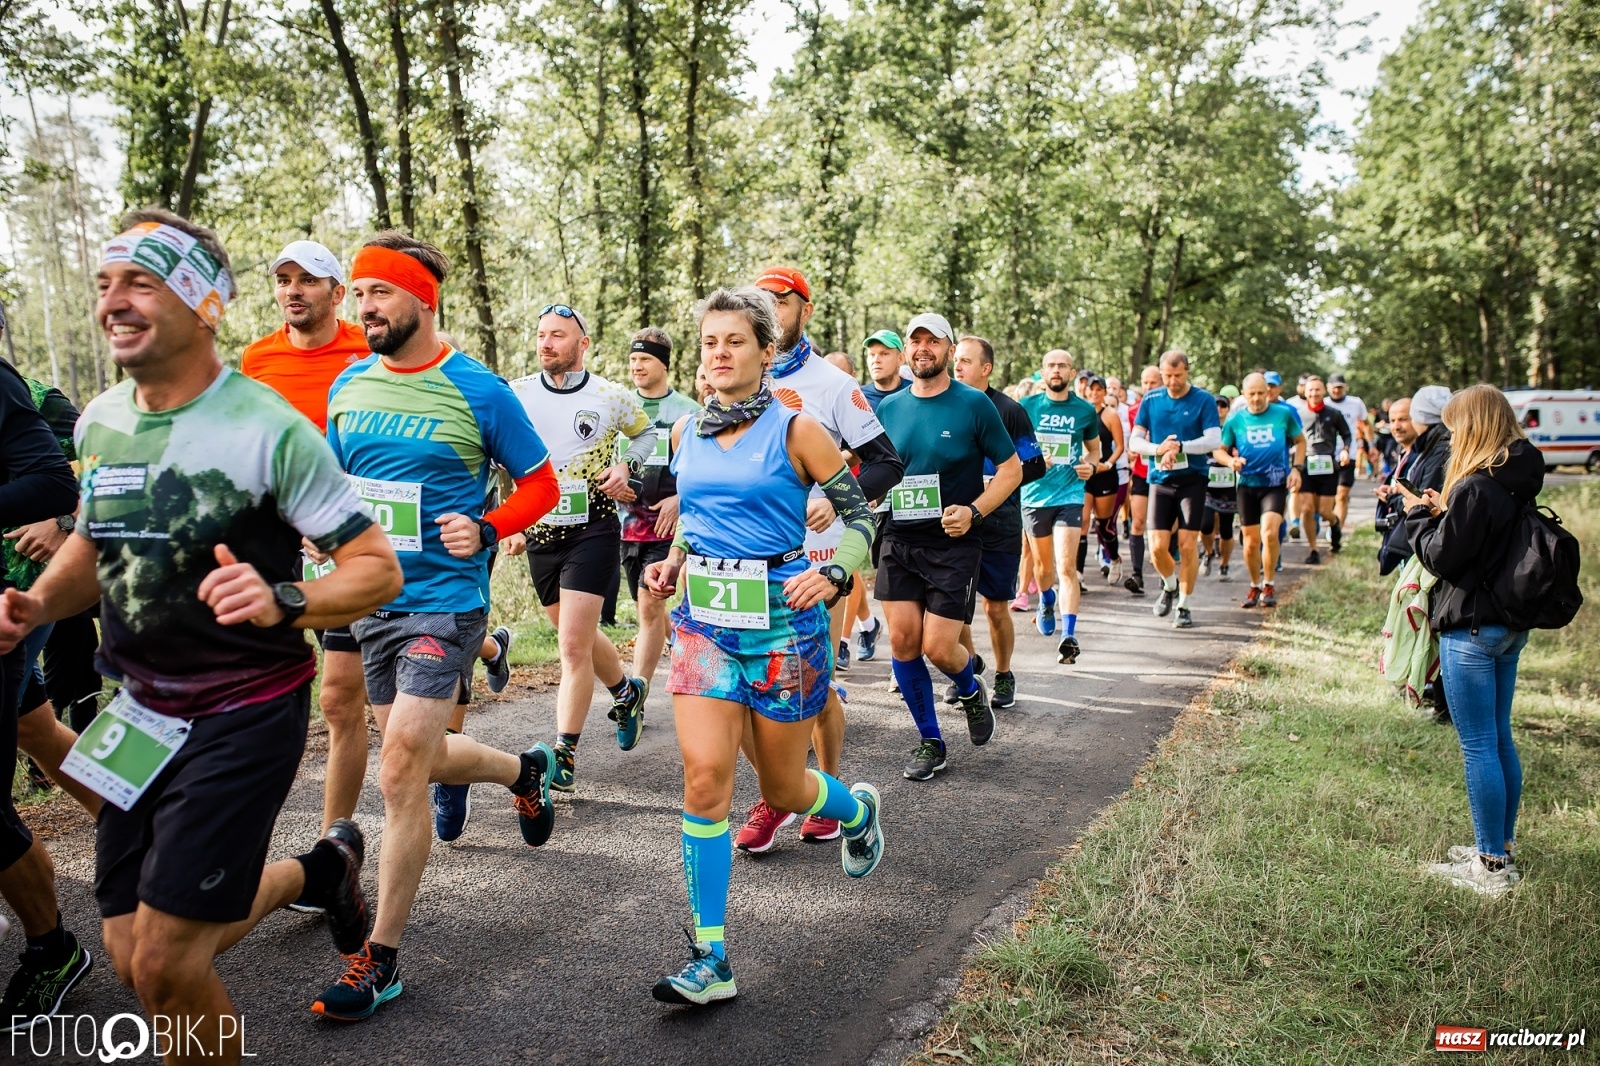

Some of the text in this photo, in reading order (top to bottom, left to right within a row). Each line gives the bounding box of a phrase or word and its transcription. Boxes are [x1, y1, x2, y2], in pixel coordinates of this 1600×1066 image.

[344, 409, 444, 440] DYNAFIT
[1039, 414, 1075, 429] ZBM
[1041, 443, 1059, 456] 57
[898, 489, 929, 509] 134
[708, 581, 738, 610] 21
[372, 611, 390, 619] ORT
[91, 722, 126, 760] 9
